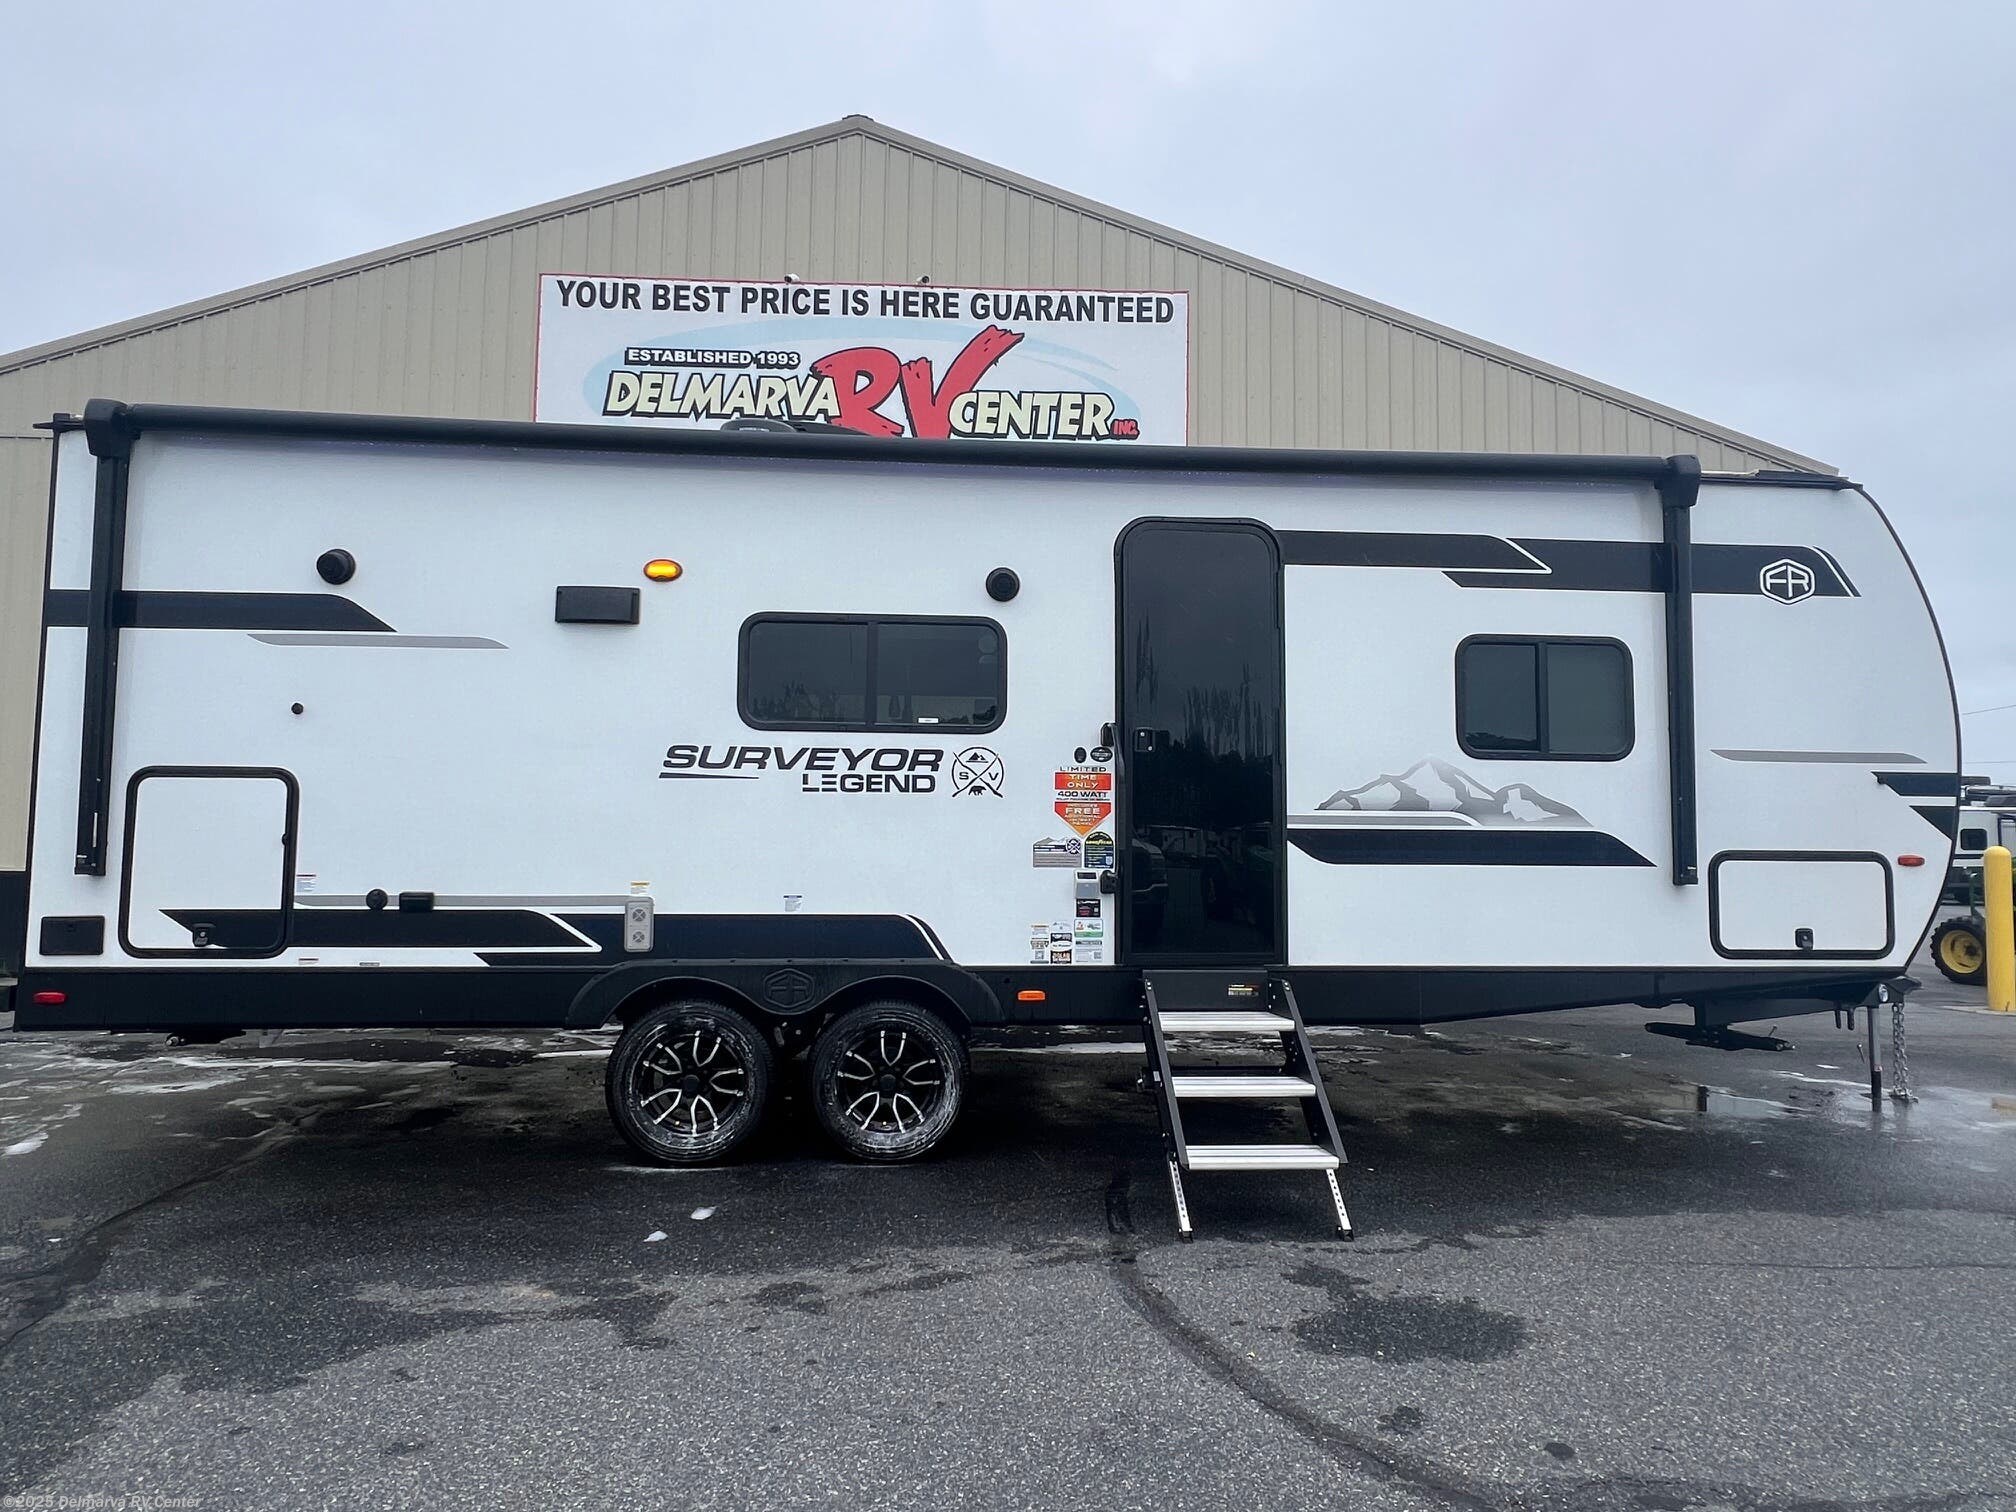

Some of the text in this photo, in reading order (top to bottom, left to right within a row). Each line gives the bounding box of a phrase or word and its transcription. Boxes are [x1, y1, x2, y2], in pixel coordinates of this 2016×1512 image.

[556, 279, 1175, 323] YOUR BEST PRICE IS HERE GUARANTEED
[627, 348, 800, 366] ESTABLISHED 1993
[602, 370, 842, 421] DELMARVA
[809, 325, 1026, 438] RV
[949, 390, 1115, 440] CENTER
[662, 744, 945, 772] SURVEYOR
[802, 773, 936, 793] LEGEND
[958, 772, 1000, 781] S V
[1057, 790, 1079, 798] 400
[1065, 807, 1101, 815] FREE
